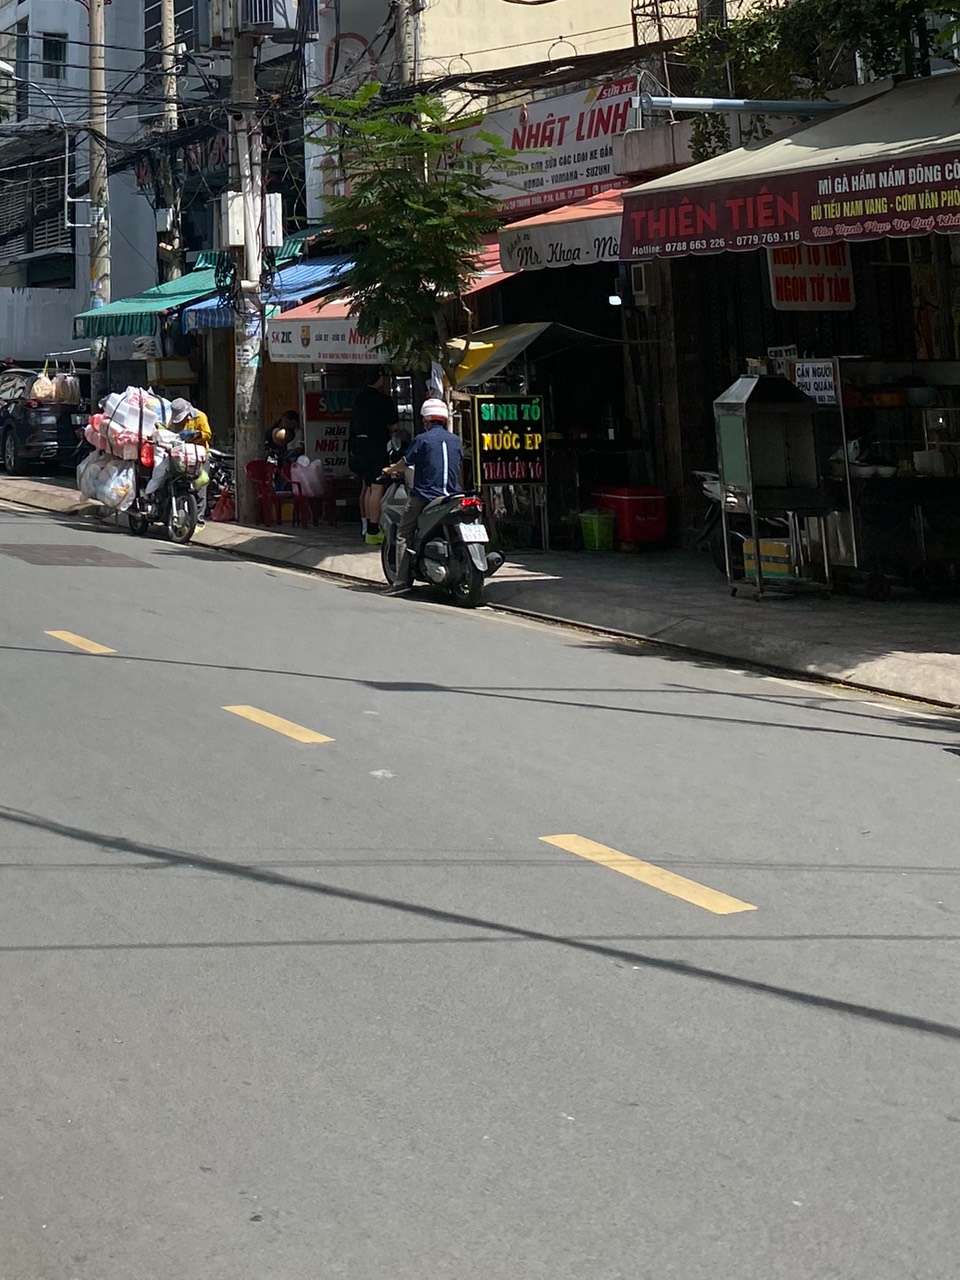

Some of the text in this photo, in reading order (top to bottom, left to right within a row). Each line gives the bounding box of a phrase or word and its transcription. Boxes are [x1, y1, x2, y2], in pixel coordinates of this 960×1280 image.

[621, 83, 633, 94] XE
[576, 99, 630, 142] LINH
[818, 176, 832, 195] MÌ
[834, 173, 849, 193] GÀ
[908, 163, 941, 185] ĐÔNG
[843, 199, 863, 217] NAM
[864, 197, 888, 215] VANG
[895, 192, 916, 212] CƠM
[546, 242, 581, 263] Khoa
[665, 241, 687, 252] 0788
[709, 238, 725, 248] 226
[481, 397, 541, 421] SINH TỐ
[481, 425, 542, 451] NƯỚC ÉP
